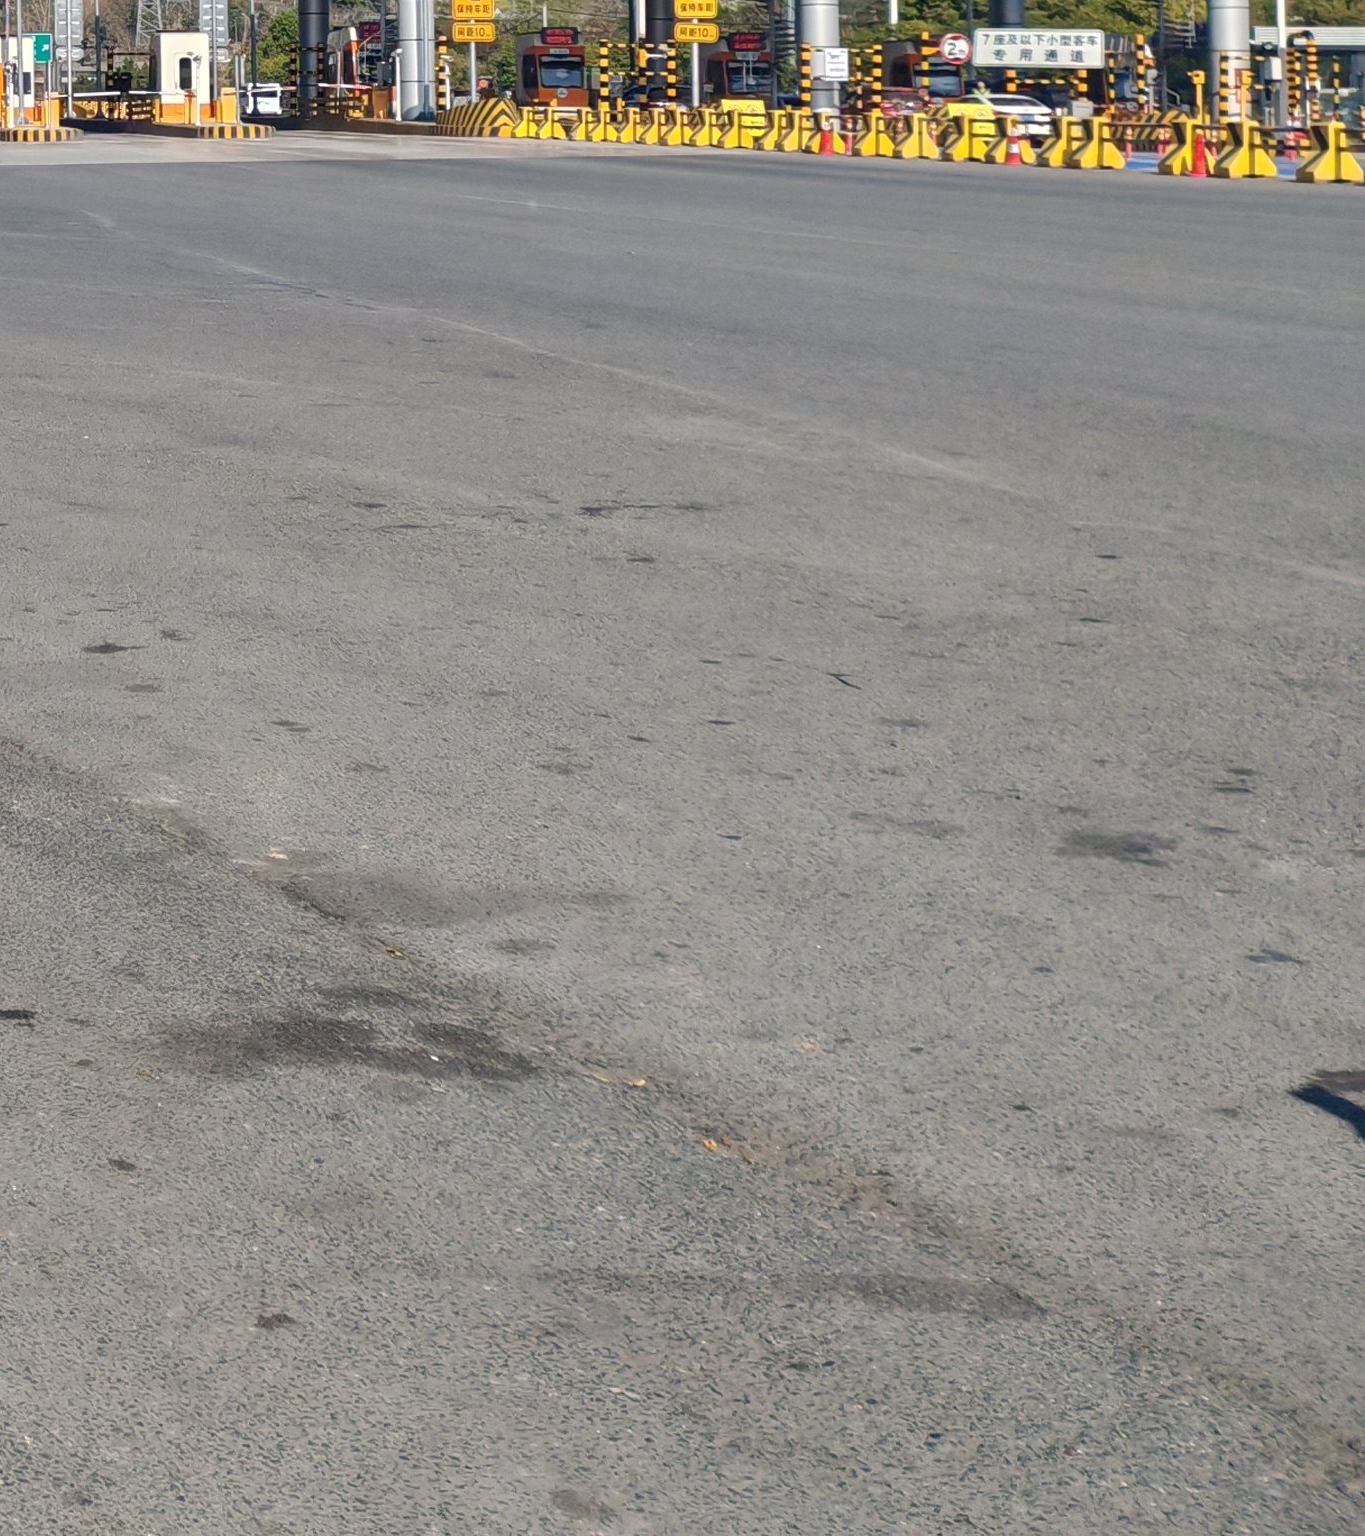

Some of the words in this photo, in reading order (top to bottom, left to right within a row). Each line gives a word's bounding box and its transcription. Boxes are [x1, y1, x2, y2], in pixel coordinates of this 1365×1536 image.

[456, 4, 490, 14] 保持车距
[679, 2, 714, 13] 保持车距
[981, 34, 1099, 46] 7座及以下小型客车
[992, 48, 1085, 62] 专用通道
